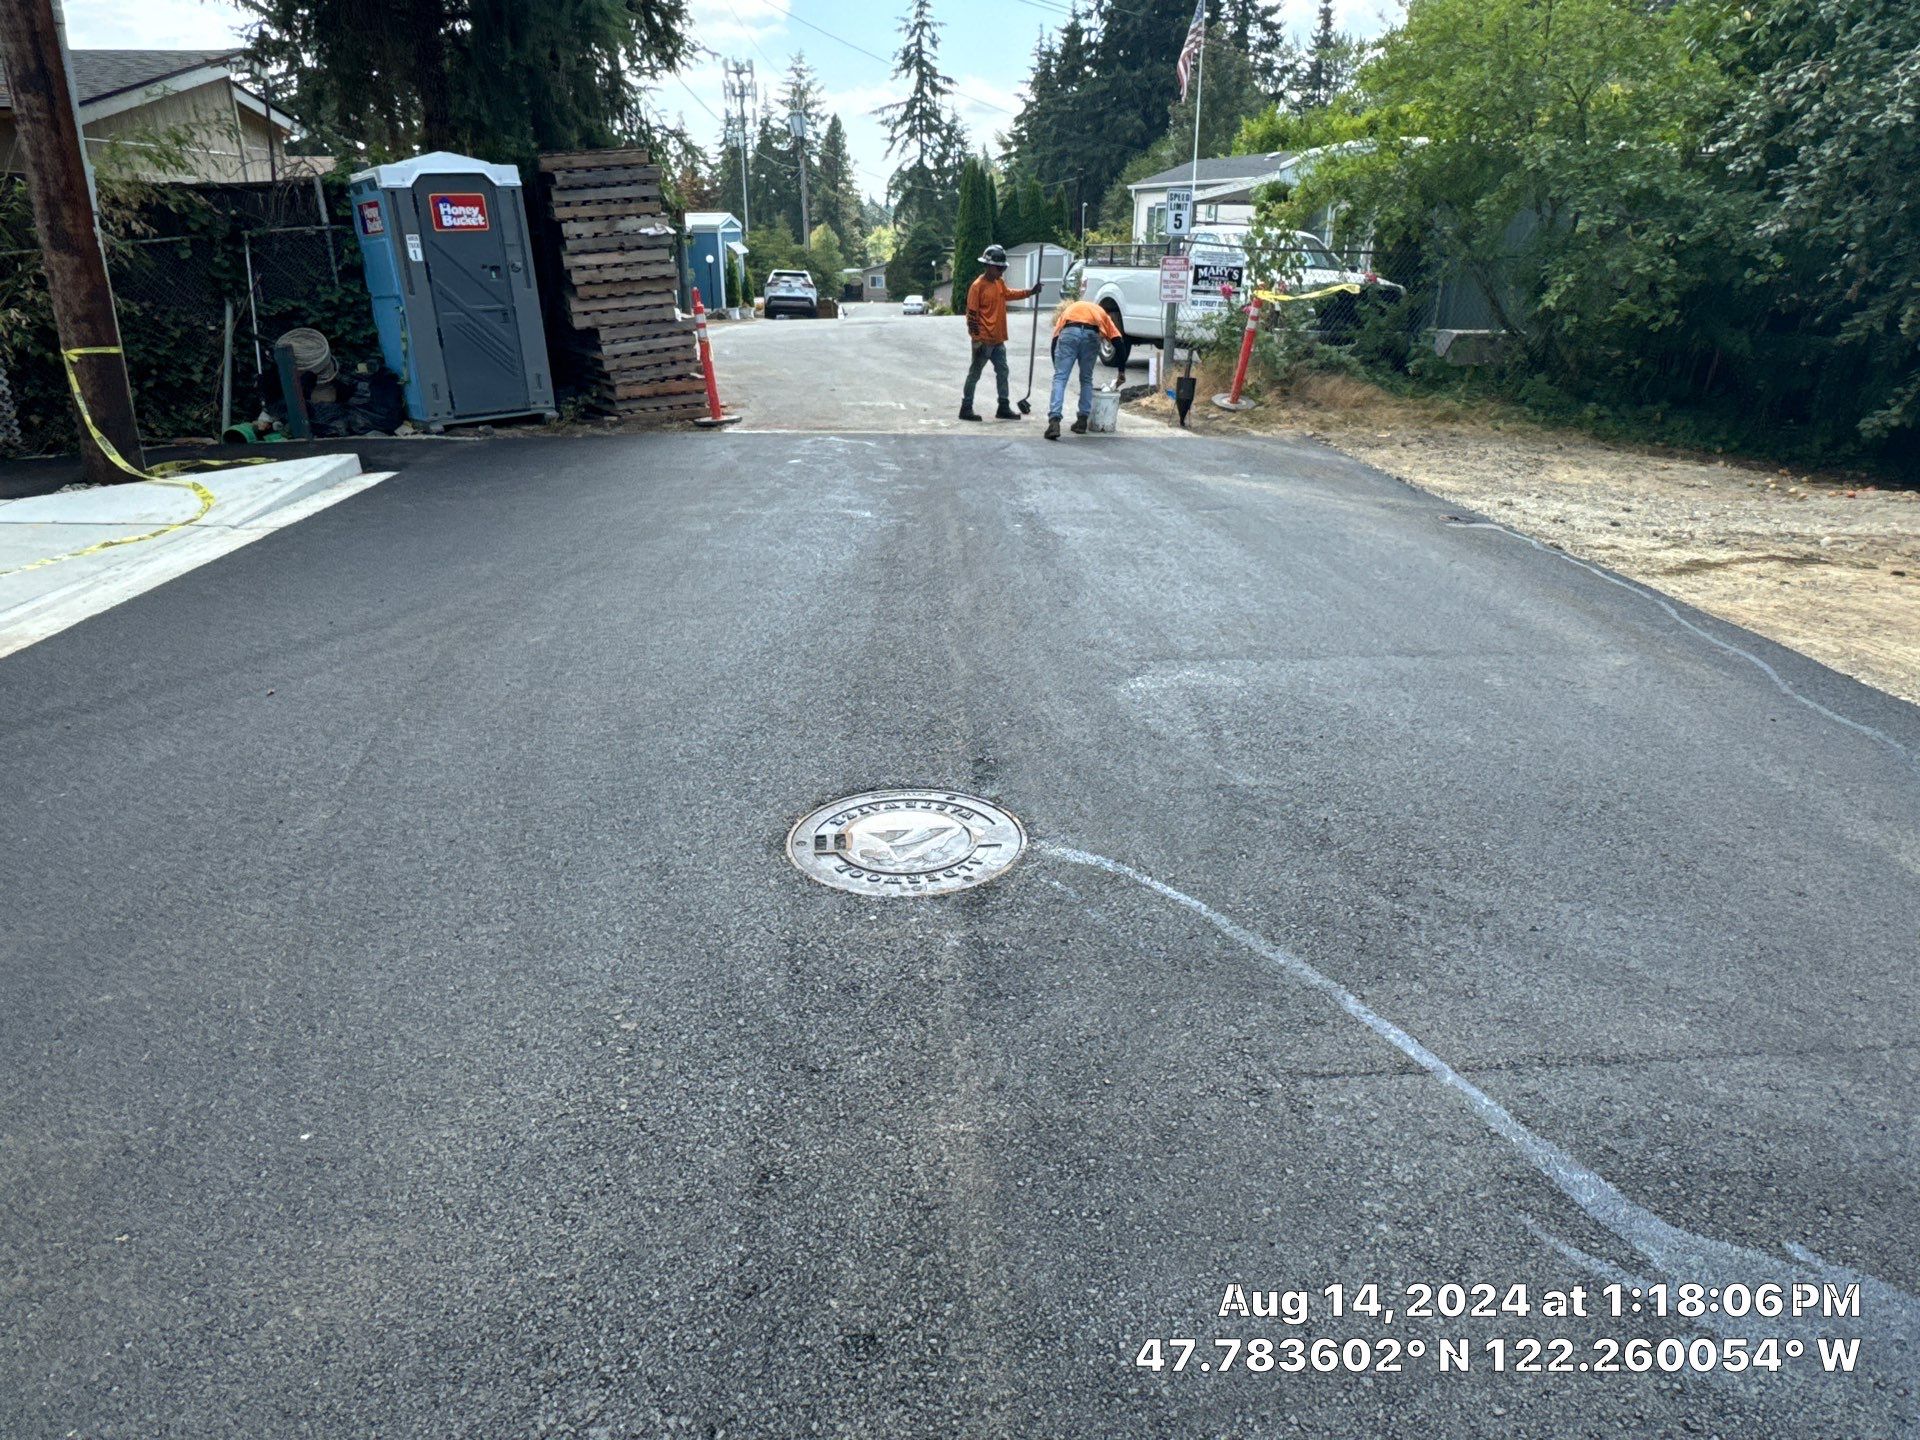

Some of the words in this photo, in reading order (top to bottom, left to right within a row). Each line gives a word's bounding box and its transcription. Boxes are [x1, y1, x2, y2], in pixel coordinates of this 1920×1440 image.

[1169, 193, 1190, 201] SPEED
[438, 202, 480, 217] Honey
[1169, 203, 1188, 211] LIMIT
[441, 214, 486, 227] Bucket
[1173, 213, 1183, 230] 5
[1198, 266, 1240, 280] MARY'S
[834, 858, 984, 885] ALDERWOOD
